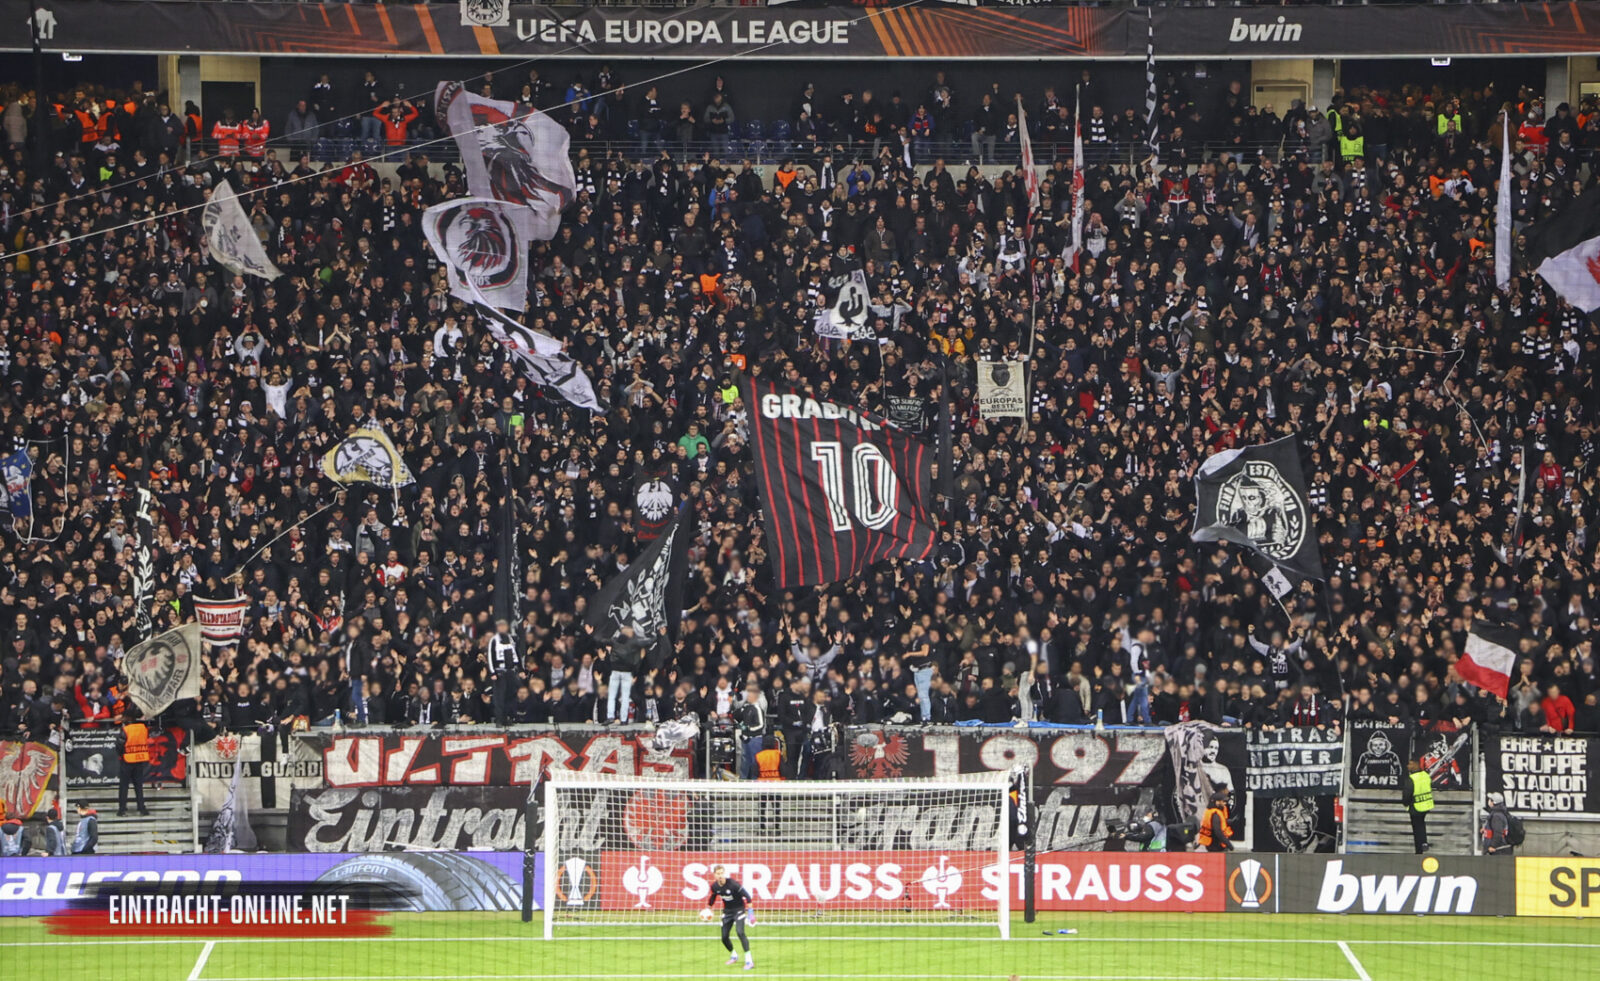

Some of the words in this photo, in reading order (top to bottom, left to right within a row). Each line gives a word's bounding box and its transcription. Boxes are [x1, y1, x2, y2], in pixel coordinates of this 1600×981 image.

[517, 19, 597, 43] UEFA
[605, 19, 723, 43] EUROPA
[731, 19, 849, 43] LEAGUE
[1229, 15, 1302, 42] bwin
[980, 397, 1024, 405] EUROPAS
[811, 441, 898, 532] 10
[1250, 750, 1332, 767] NEVER
[1500, 736, 1542, 753] EHRE
[1554, 737, 1588, 754] DER
[199, 761, 252, 778] NUOA
[324, 733, 693, 788] ULTRAS
[922, 733, 1166, 785] 1997
[1501, 753, 1587, 775] GRUPPE
[1502, 773, 1587, 792] STADION
[1503, 790, 1587, 812] VERBOT
[838, 786, 1156, 852] Franfurt
[681, 862, 903, 901] STRAUSS
[980, 862, 1204, 902] STRAUSS
[1317, 857, 1477, 913] bwin
[1549, 866, 1600, 908] SP
